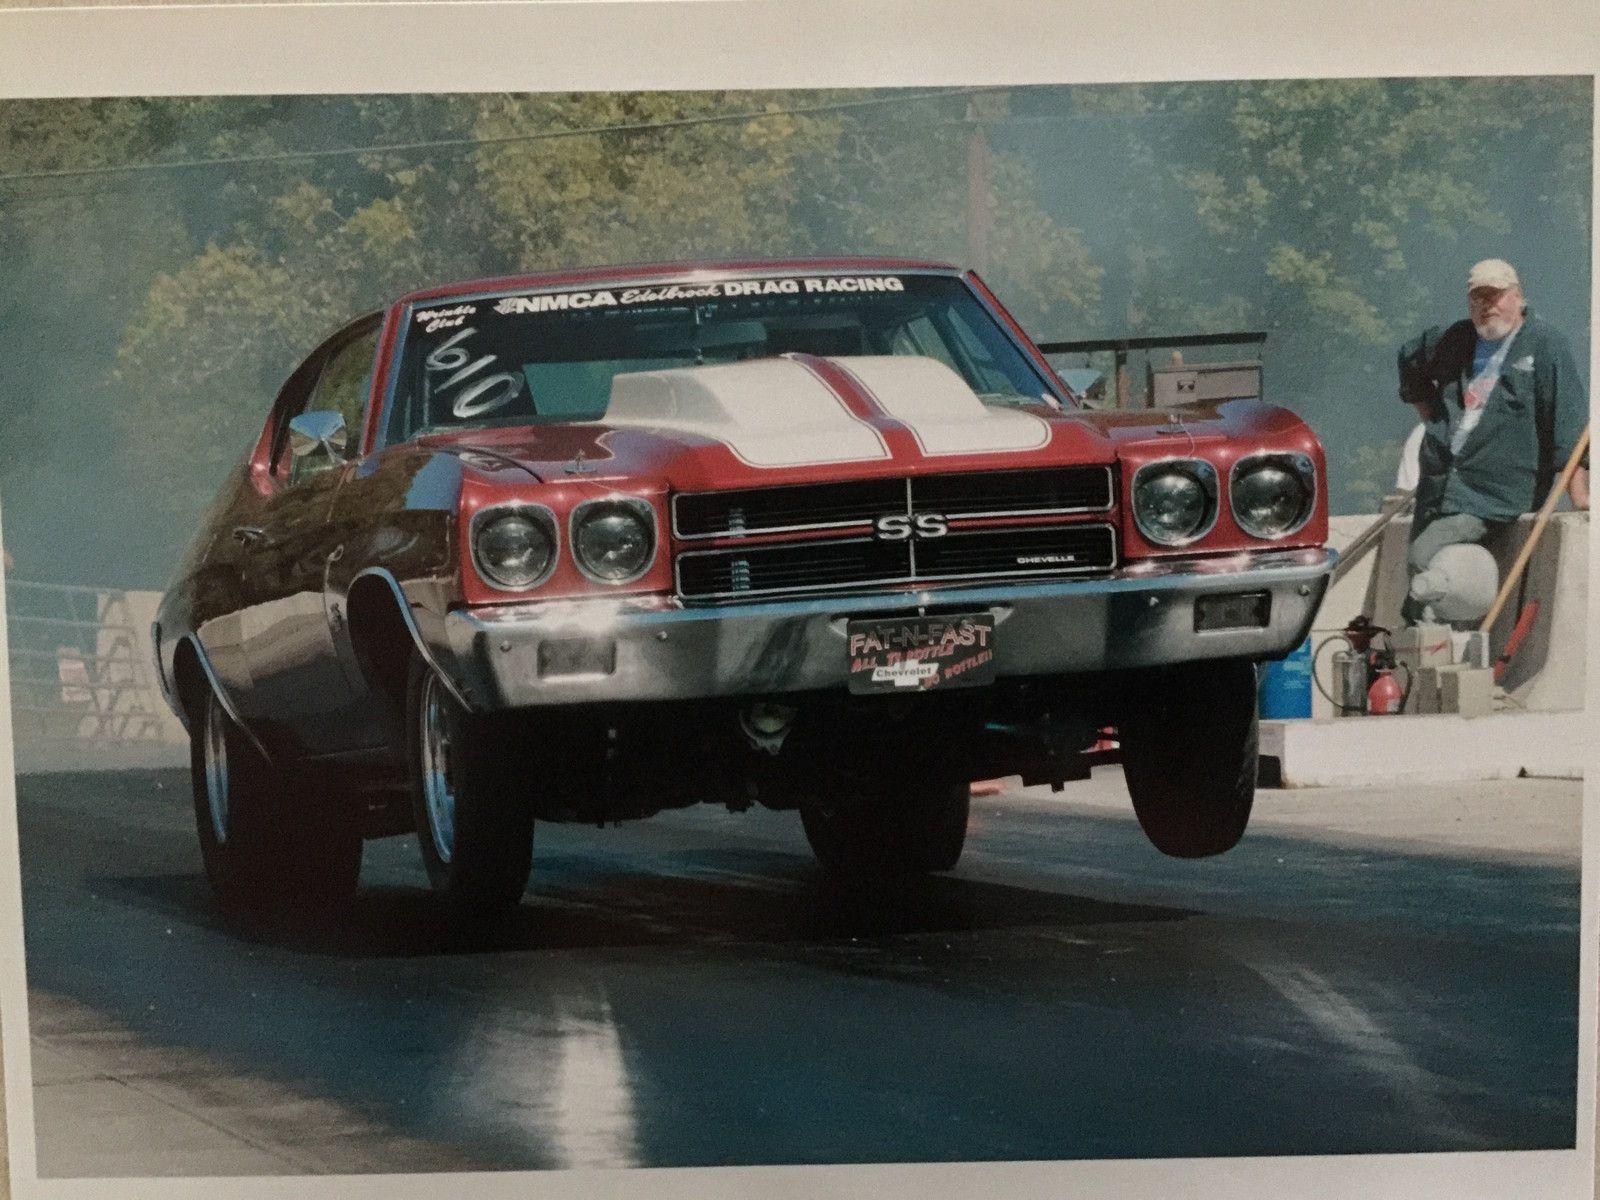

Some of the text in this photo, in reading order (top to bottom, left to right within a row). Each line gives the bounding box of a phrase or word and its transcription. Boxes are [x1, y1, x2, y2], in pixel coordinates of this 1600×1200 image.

[515, 277, 904, 315] NMCA Edelbrock DRAG RACING
[877, 514, 948, 540] SS
[1016, 555, 1075, 564] CHEVELLE
[850, 622, 992, 656] FAT-N-FAST
[876, 667, 932, 678] Chevrolet
